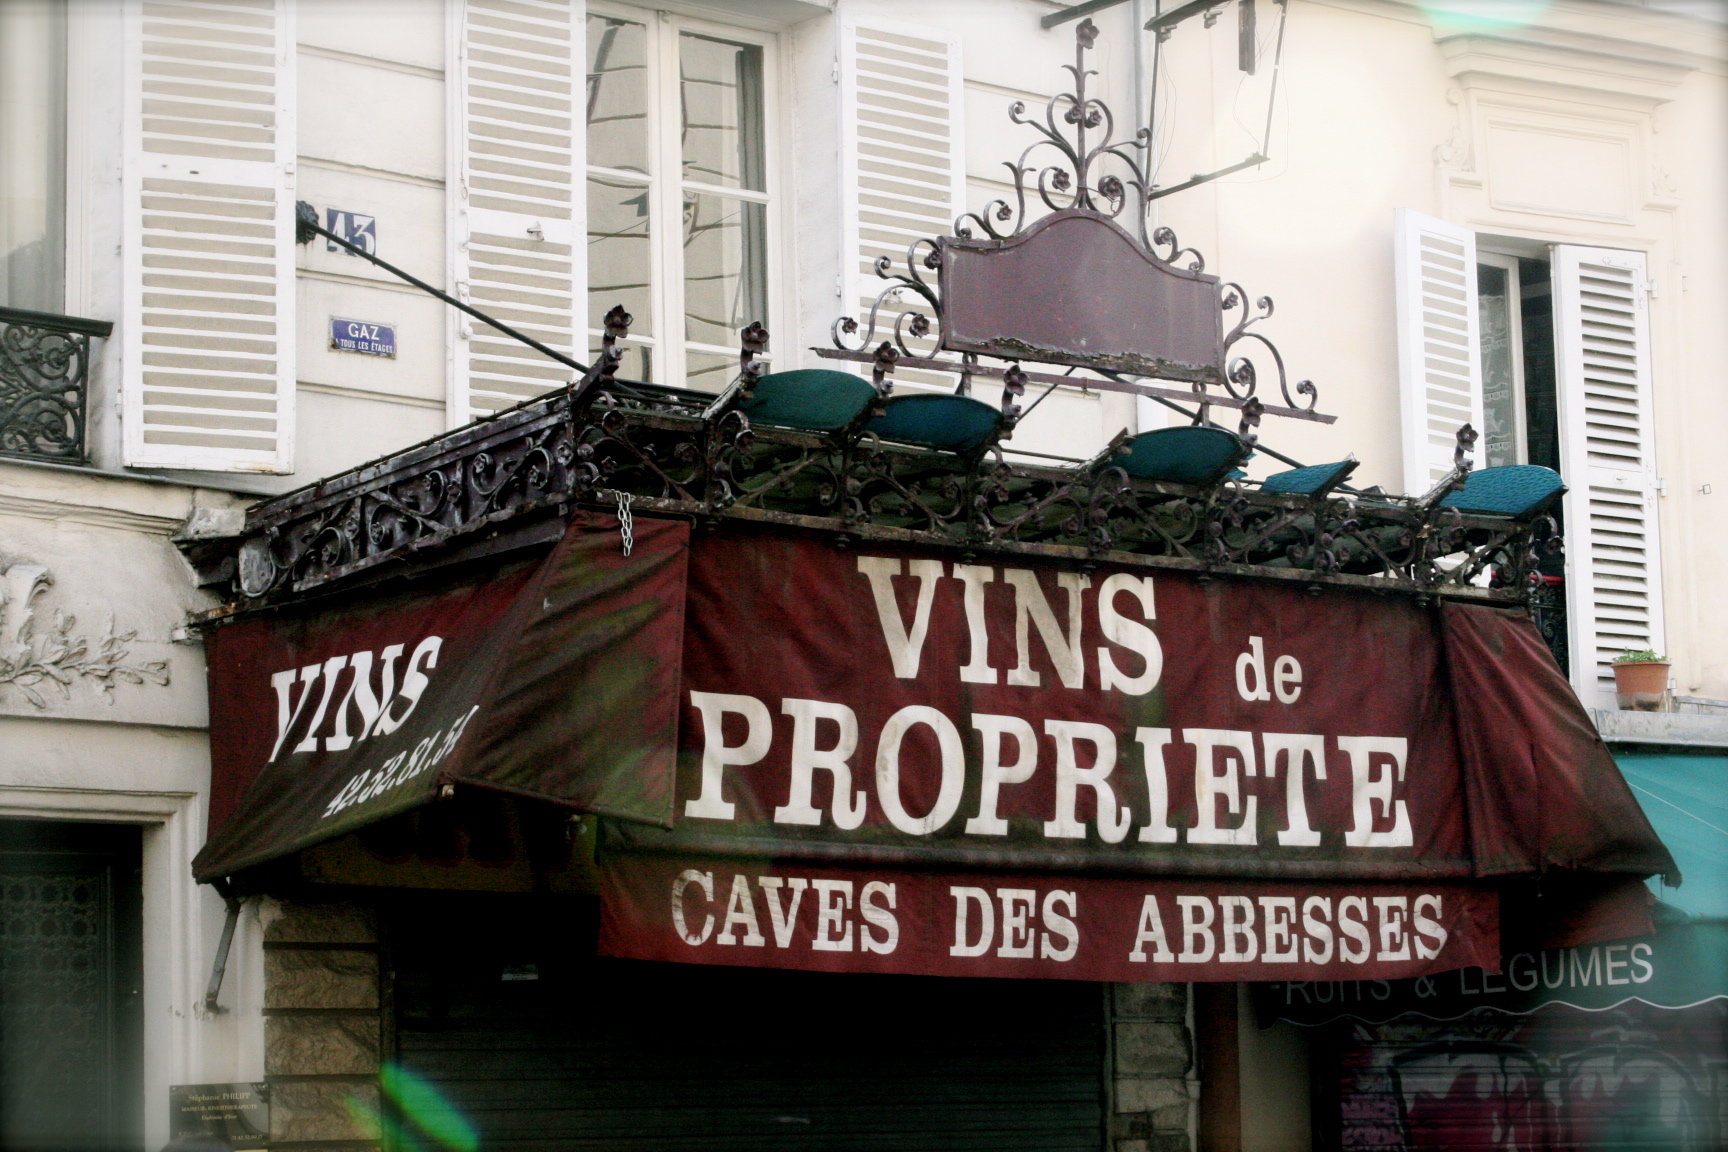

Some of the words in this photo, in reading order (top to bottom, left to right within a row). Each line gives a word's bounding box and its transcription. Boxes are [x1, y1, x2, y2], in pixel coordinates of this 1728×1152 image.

[328, 213, 374, 258] 43
[340, 339, 356, 349] TOUS
[358, 341, 369, 350] LES
[371, 342, 393, 354] ÉTAGES
[348, 323, 380, 341] GAZ
[858, 557, 1163, 696] VINS
[1236, 636, 1302, 704] de
[269, 636, 443, 762] VINS
[685, 691, 1413, 847] PROPRIETE
[672, 869, 899, 955] CAVES
[950, 886, 1079, 962] DES
[1130, 895, 1448, 964] ABBESSES
[1415, 976, 1437, 999] &
